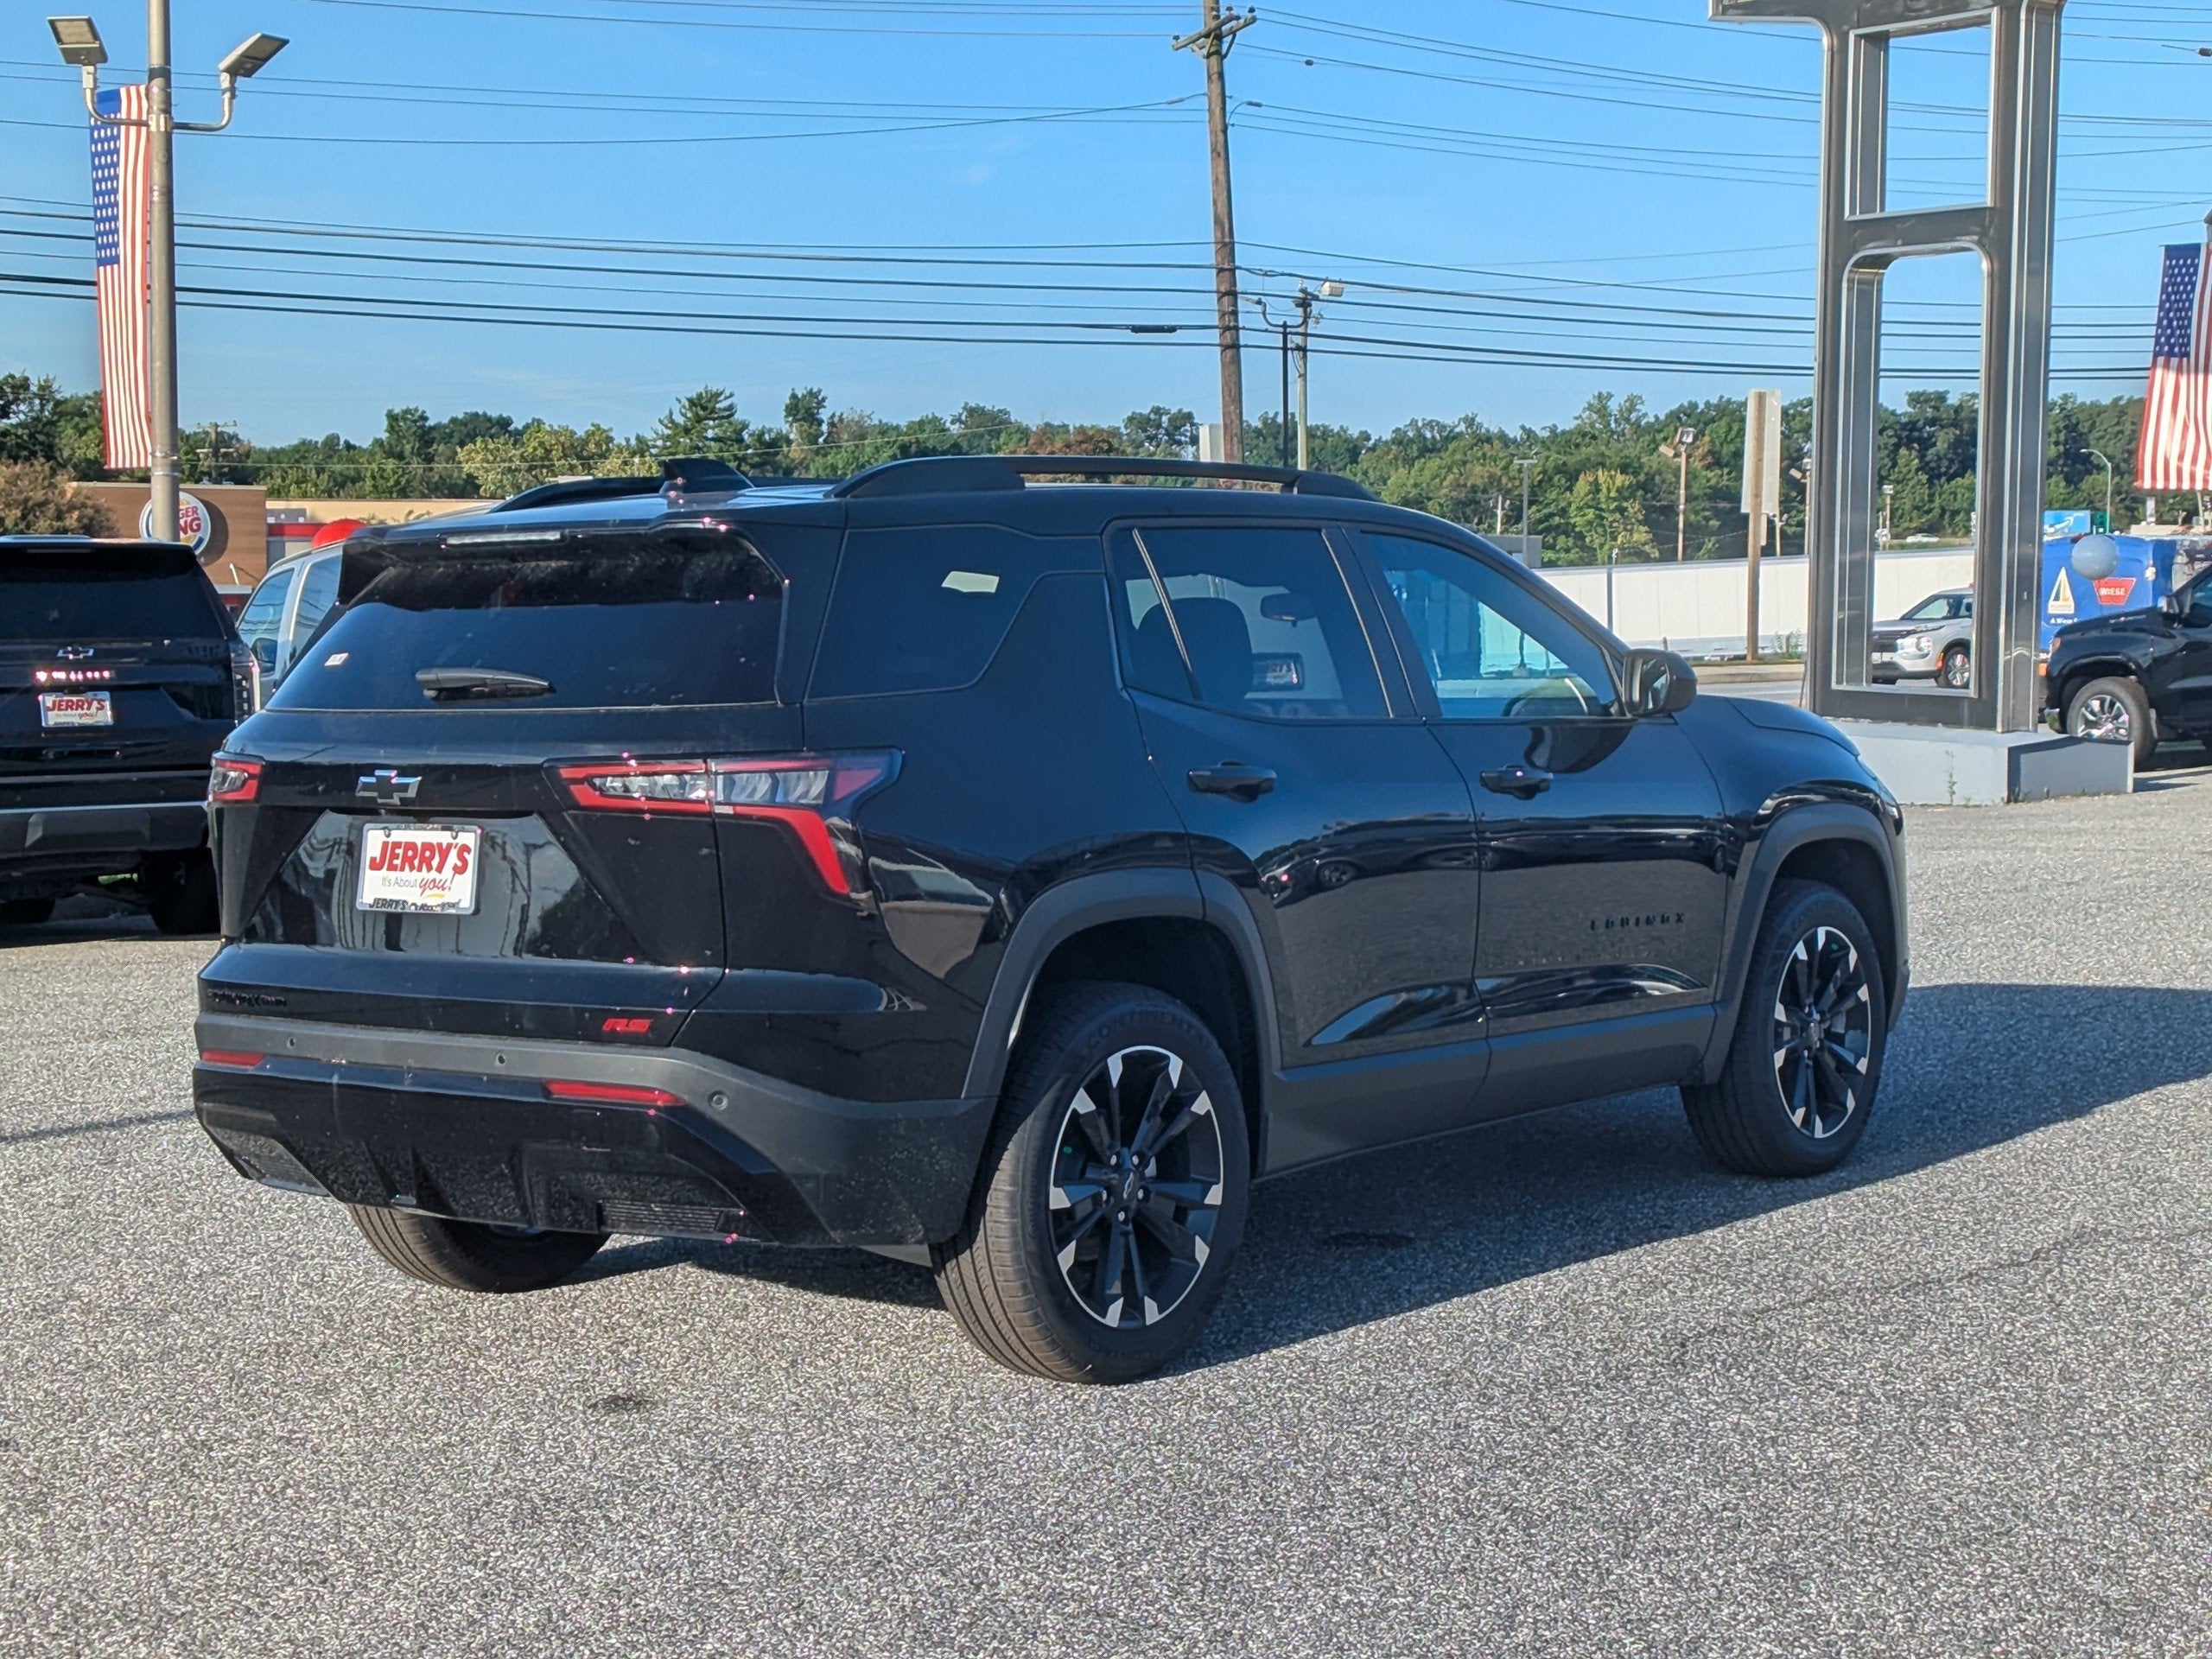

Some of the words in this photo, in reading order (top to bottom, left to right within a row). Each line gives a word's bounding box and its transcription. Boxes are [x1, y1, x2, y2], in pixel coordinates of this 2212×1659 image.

[179, 505, 200, 519] GER
[179, 517, 201, 536] NG
[46, 698, 105, 712] JERRY'S
[369, 841, 472, 875] JERRY'S
[382, 876, 391, 887] It's
[393, 876, 417, 887] About
[418, 873, 455, 897] you!
[602, 1018, 651, 1033] RS
